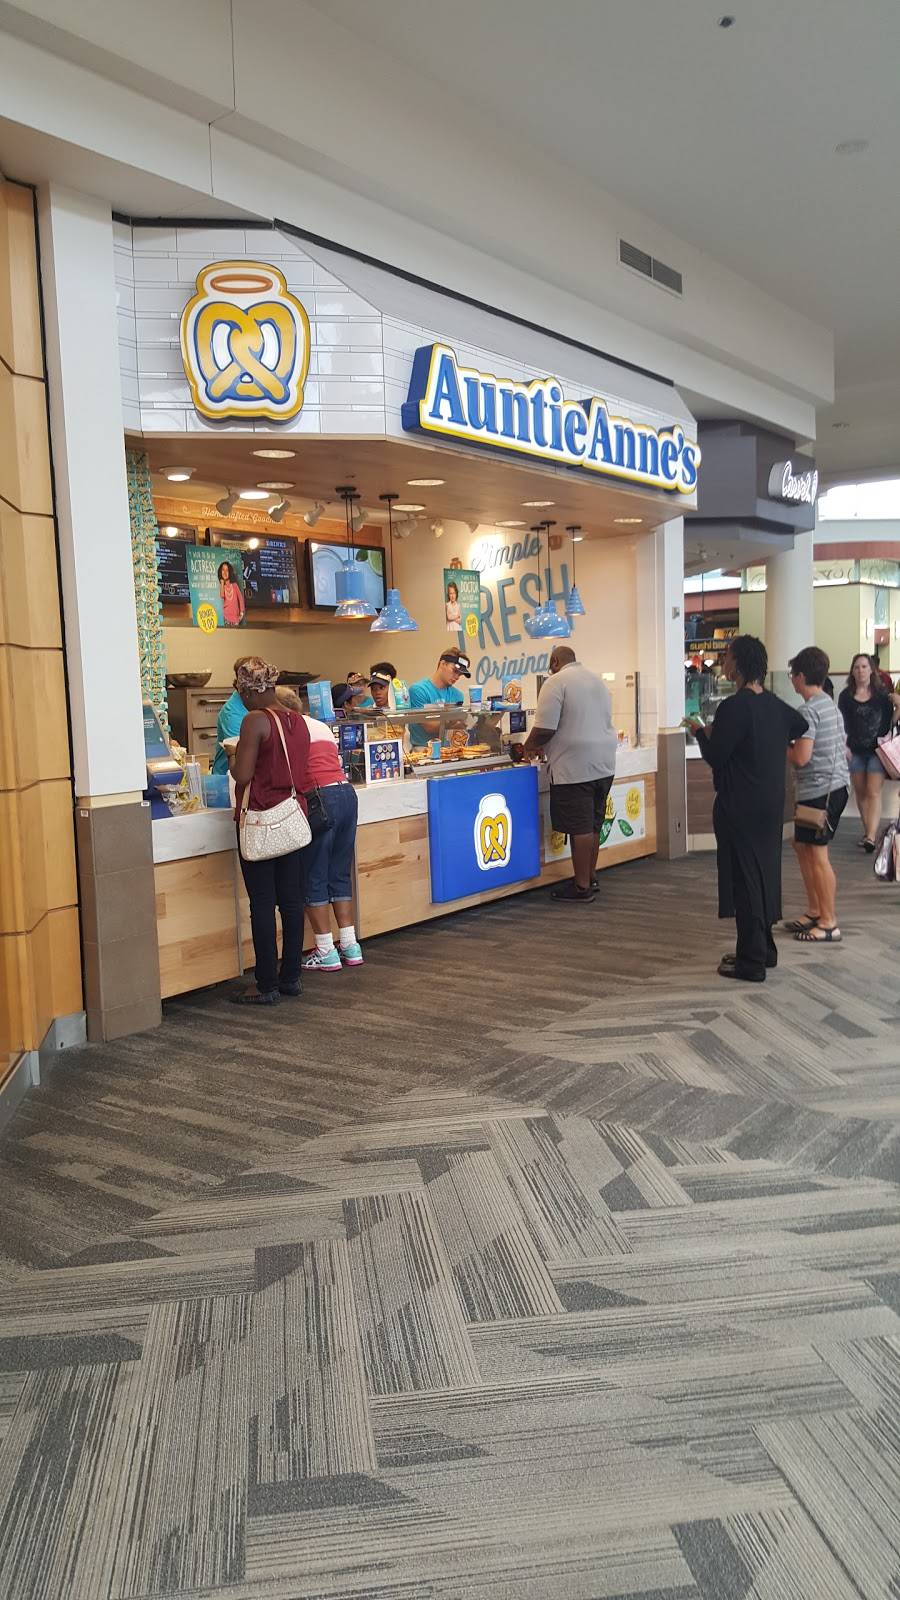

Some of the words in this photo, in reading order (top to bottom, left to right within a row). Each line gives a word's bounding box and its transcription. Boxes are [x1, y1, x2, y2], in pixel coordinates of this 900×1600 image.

[428, 354, 587, 456] Auntie
[587, 406, 697, 486] Anne's
[202, 506, 250, 521] Hanrafted
[191, 559, 216, 574] ACTRESS
[471, 533, 543, 574] Simple
[457, 564, 576, 652] RESH
